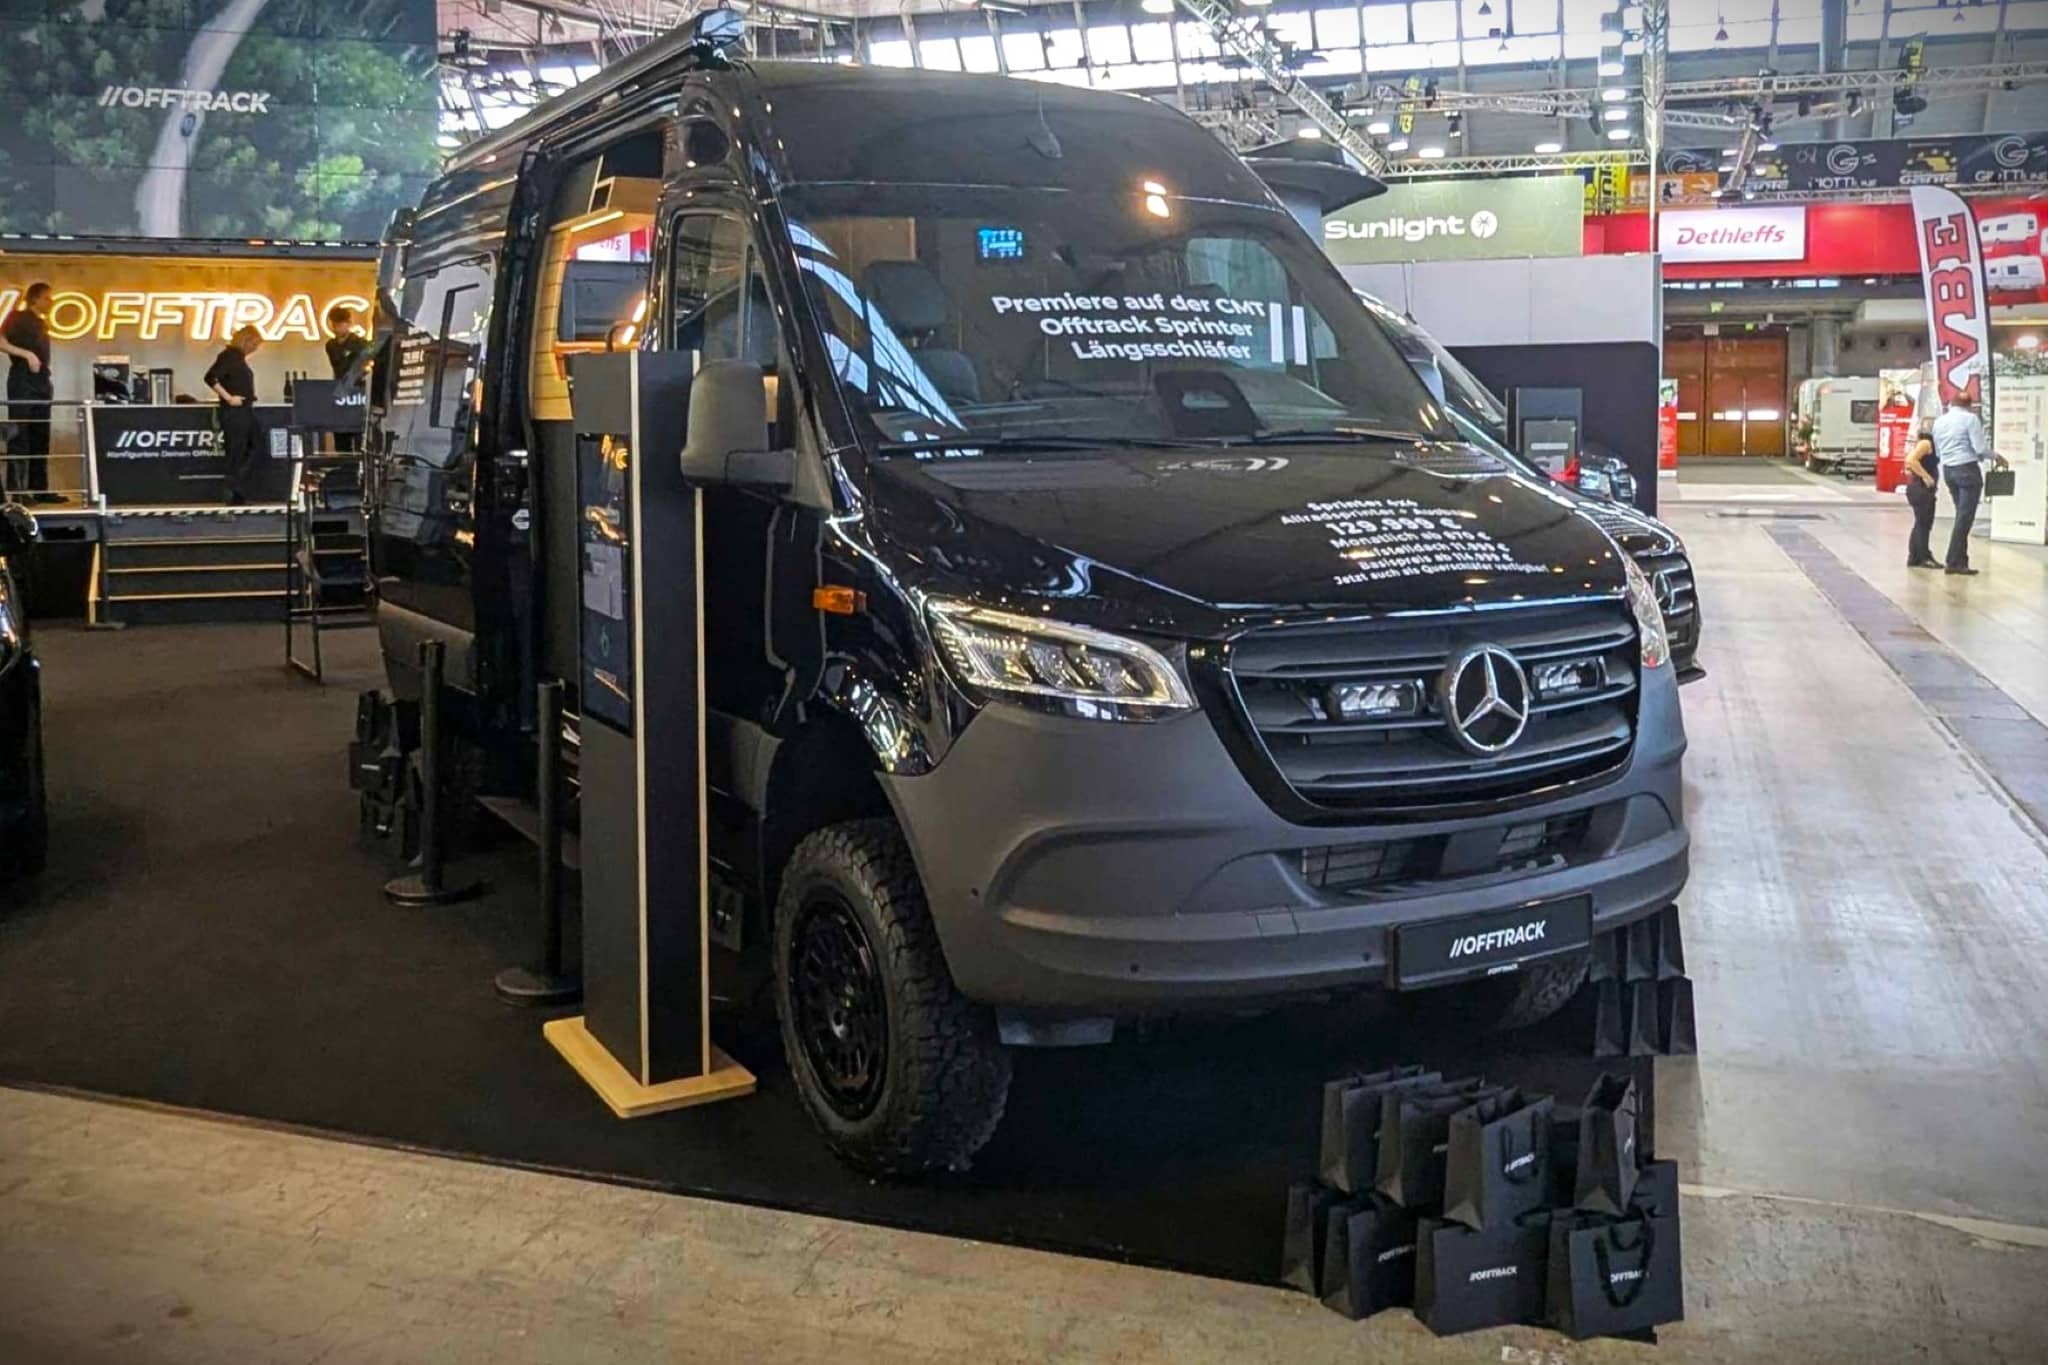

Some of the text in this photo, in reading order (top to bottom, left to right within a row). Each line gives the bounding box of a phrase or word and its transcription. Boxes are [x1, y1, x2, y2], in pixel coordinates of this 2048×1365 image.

[1324, 215, 1466, 242] Sunlight
[1676, 224, 1786, 245] Dethleffs
[991, 292, 1268, 318] Premiere auf der CMT
[1039, 315, 1254, 340] Offtrack Sprinter
[1071, 338, 1252, 361] Längsschläfer
[1307, 500, 1382, 513] Sprinter
[1329, 531, 1419, 549] Monatlich
[1334, 572, 1369, 586] Jetzt
[1449, 920, 1546, 958] //OFFTRACK
